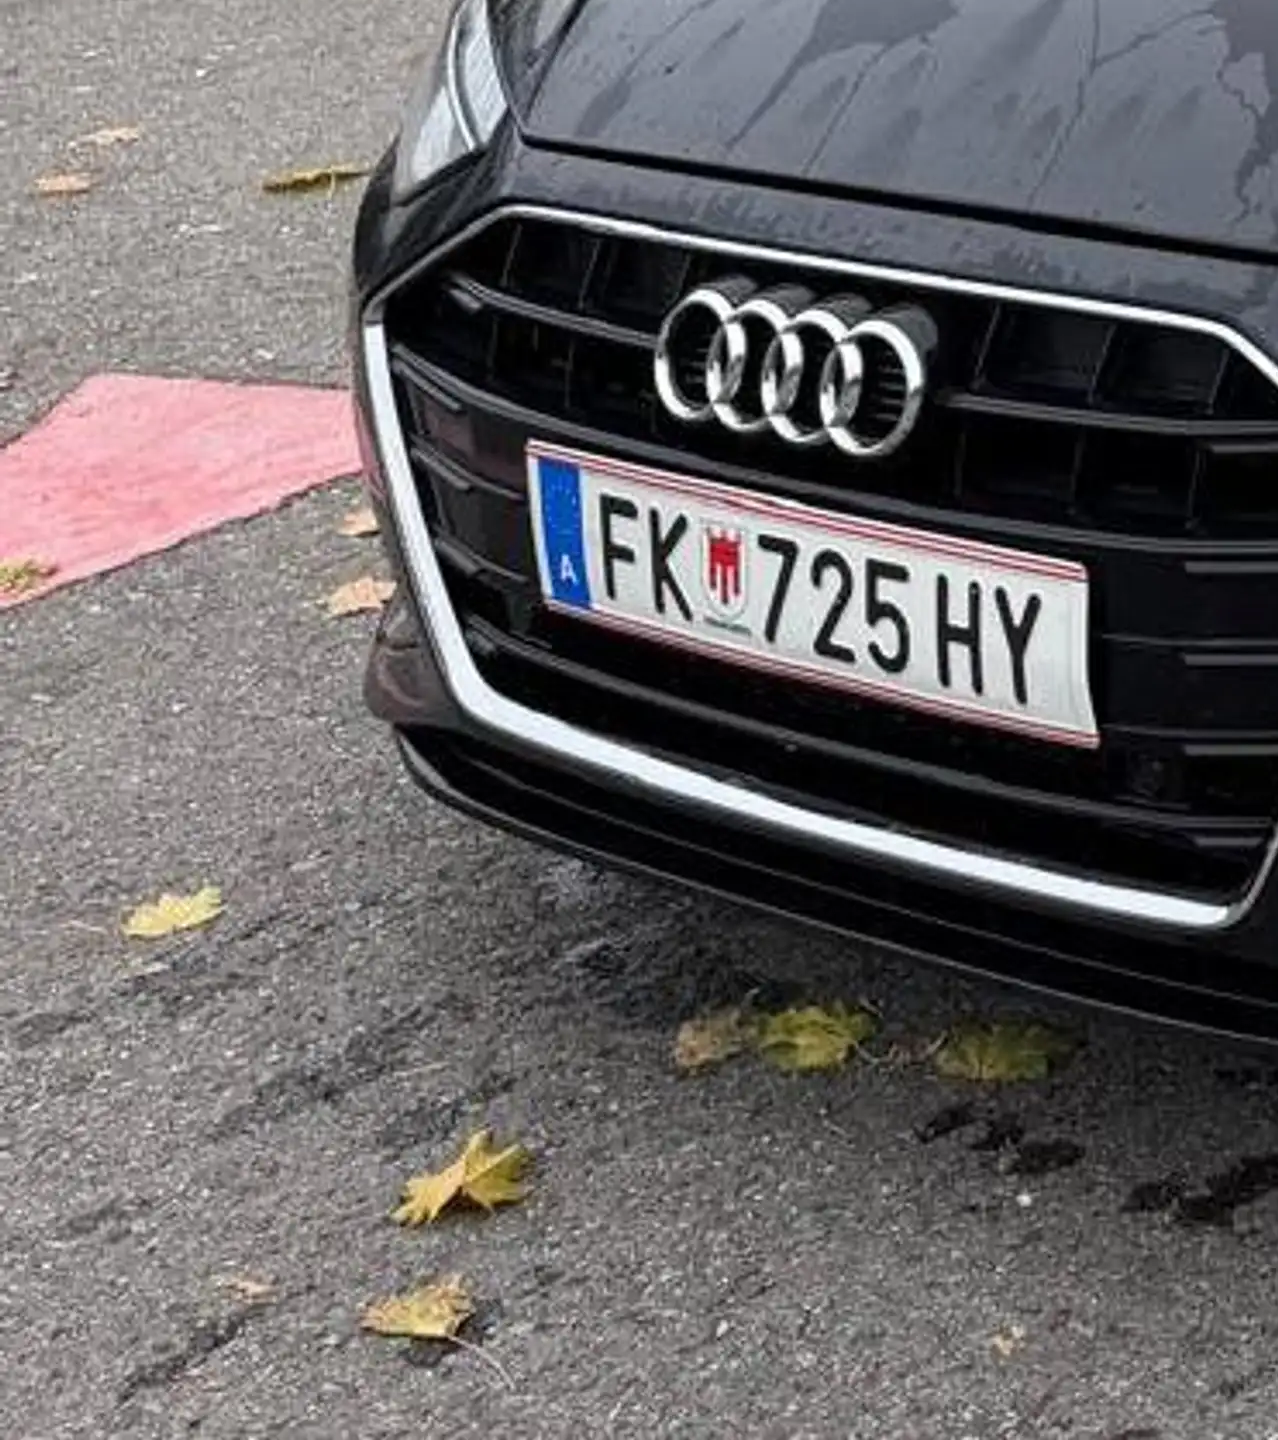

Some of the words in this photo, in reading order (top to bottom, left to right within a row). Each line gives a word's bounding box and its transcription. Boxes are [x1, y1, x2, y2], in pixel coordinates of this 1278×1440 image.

[561, 554, 577, 584] A
[598, 492, 693, 623] FK
[757, 534, 910, 674] 725
[936, 573, 1041, 706] HY
